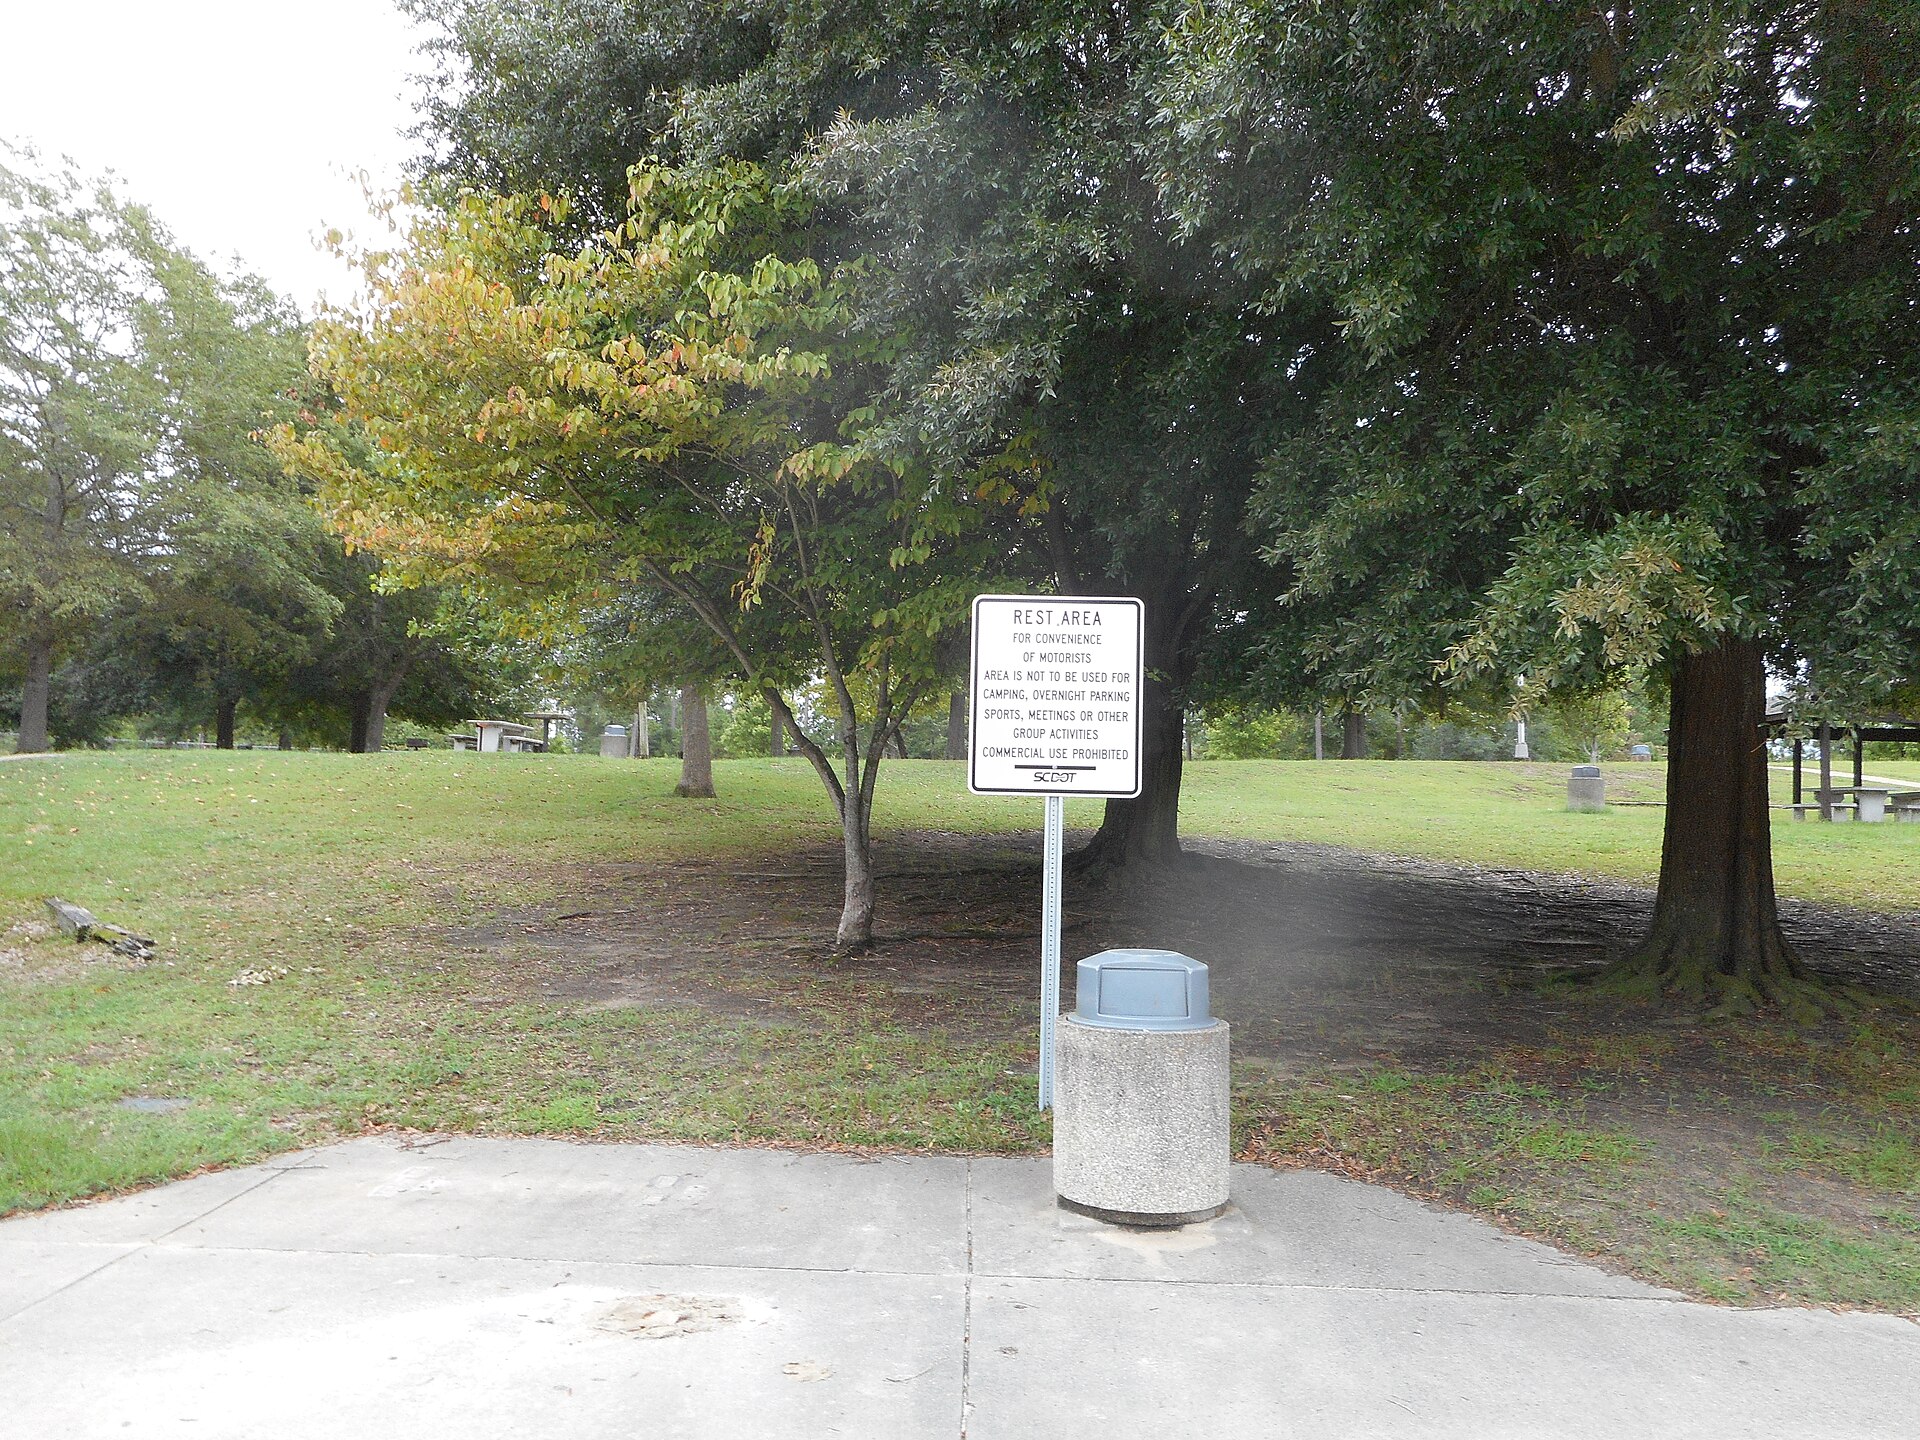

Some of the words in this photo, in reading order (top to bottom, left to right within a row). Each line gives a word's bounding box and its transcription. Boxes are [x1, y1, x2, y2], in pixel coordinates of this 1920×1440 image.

[1014, 610, 1053, 624] REST
[1061, 611, 1101, 625] AREA
[1013, 633, 1031, 643] FOR
[1036, 634, 1102, 644] CONVENIENCE
[1024, 652, 1035, 662] OF
[1040, 653, 1091, 663] MOTORISTS
[984, 671, 1009, 680] AREA
[1014, 671, 1022, 681] IS
[1027, 671, 1045, 681] NOT
[1050, 672, 1060, 681] TO
[1065, 672, 1077, 682] BE
[1082, 672, 1107, 682] USED
[1112, 673, 1130, 683] FOR
[984, 689, 1028, 701] CAMPING,
[1033, 690, 1085, 701] OVERNIGHT
[1090, 691, 1130, 702] PARKING
[984, 709, 1023, 721] SPORTS,
[1029, 710, 1075, 721] MEETINGS
[1080, 711, 1093, 721] OR
[1098, 712, 1128, 722] OTHER
[1014, 728, 1045, 738] GROUP
[1050, 729, 1098, 739] ACTIVITIES
[983, 747, 1044, 758] COMMERCIAL
[1049, 748, 1067, 758] USE
[1073, 749, 1128, 760] PROHIBITED
